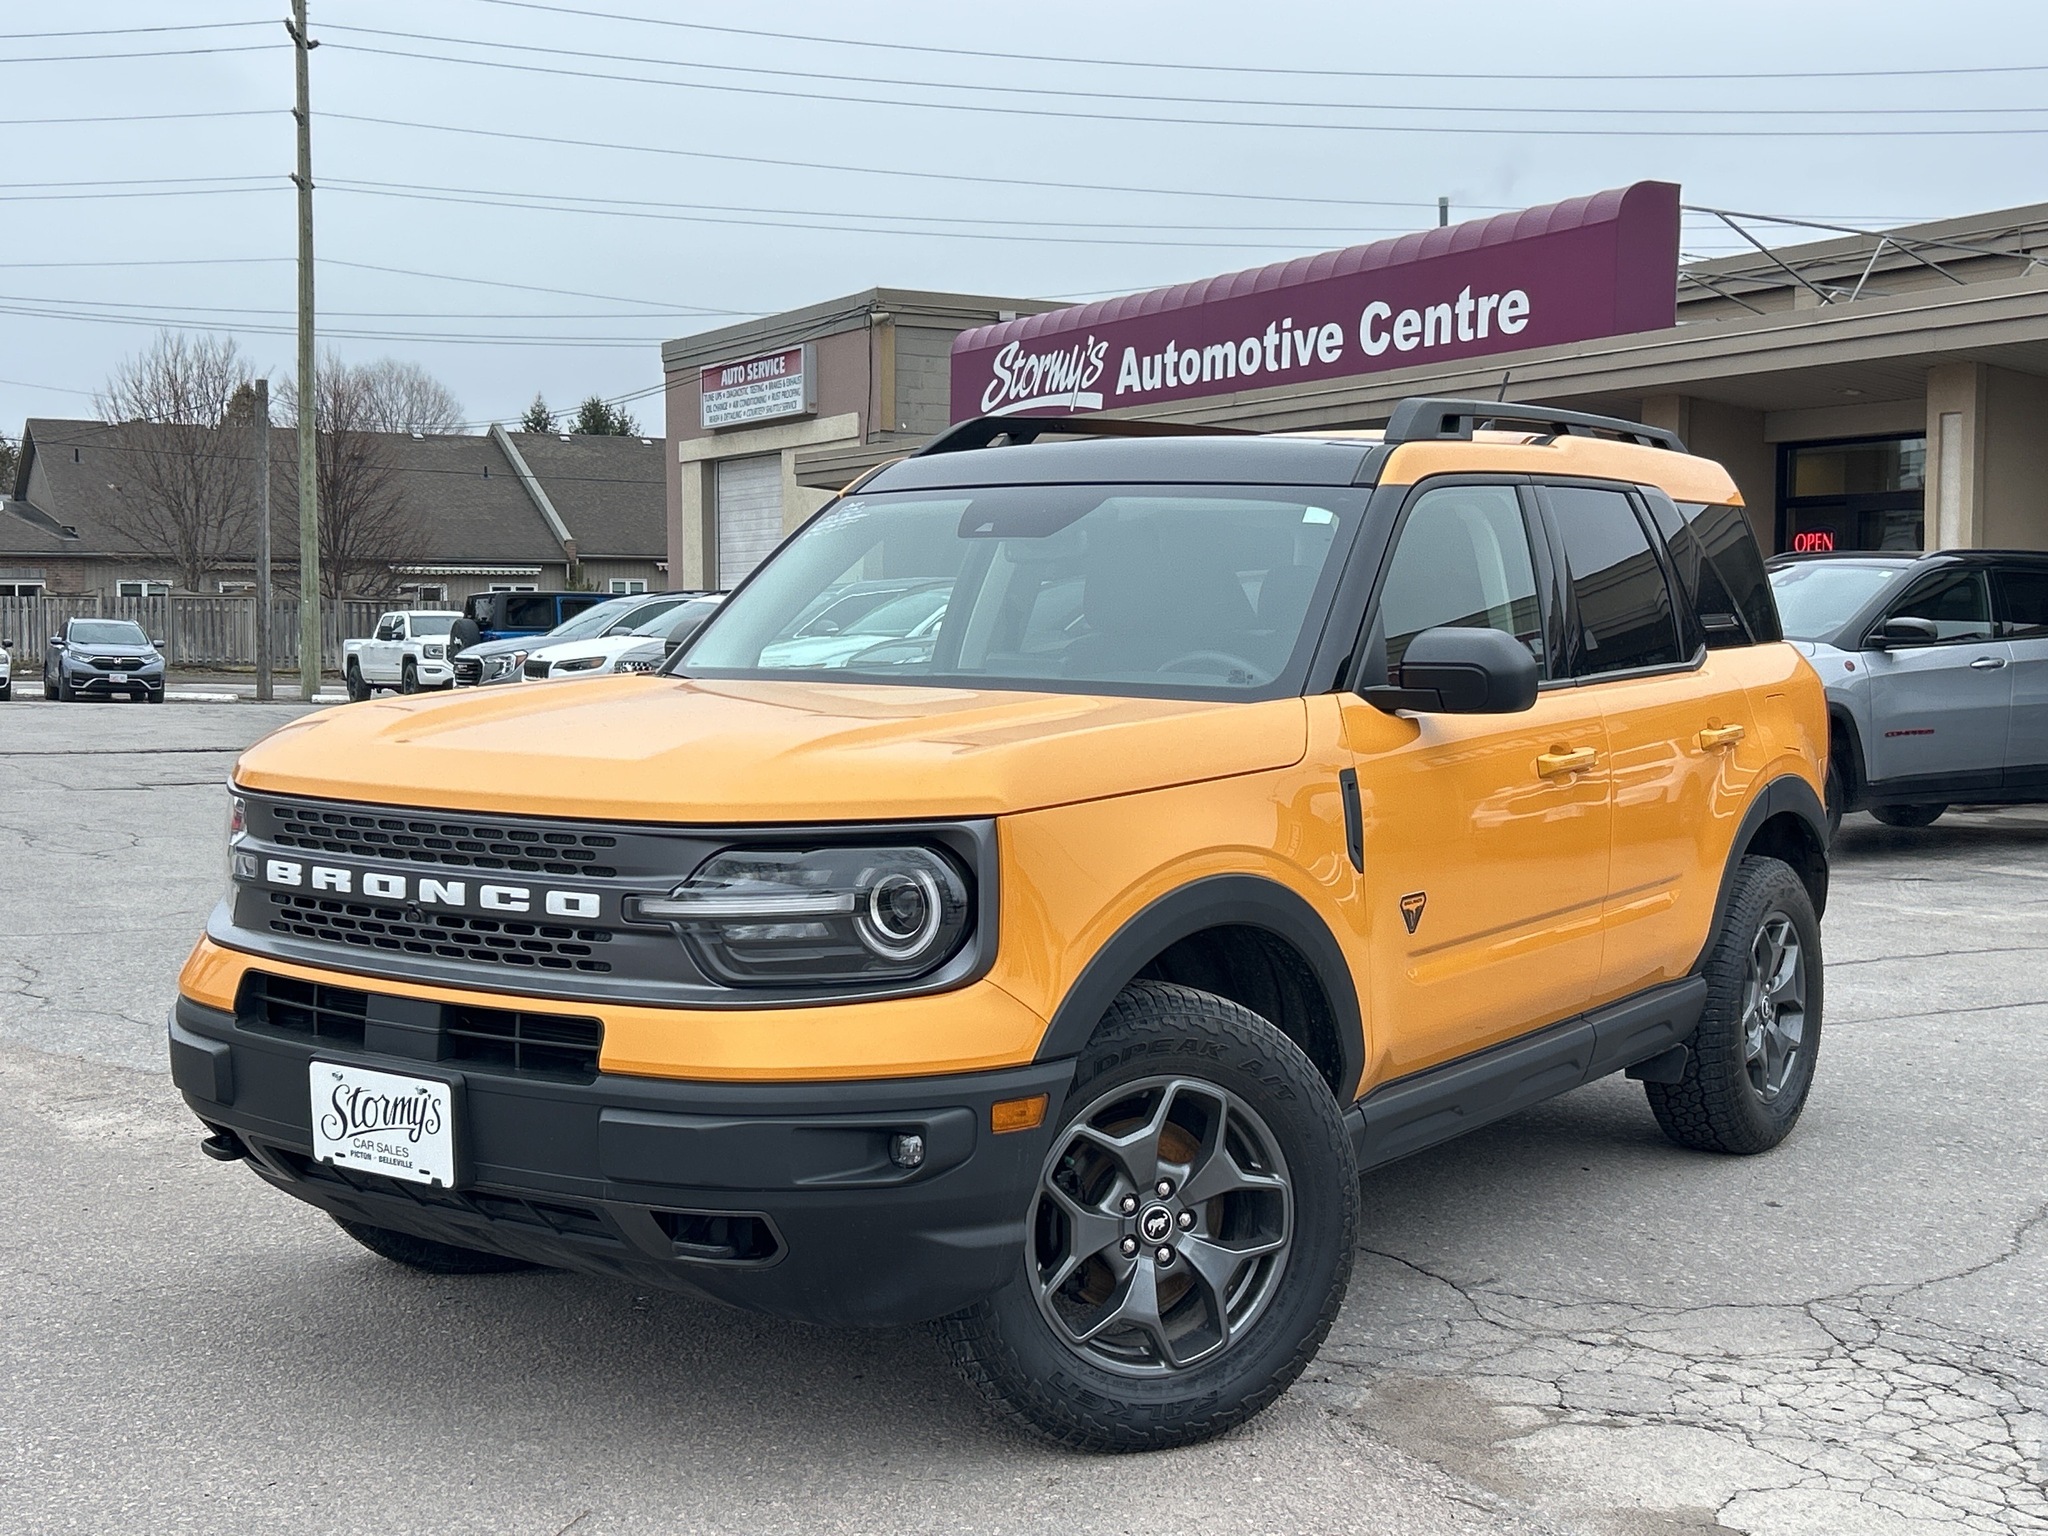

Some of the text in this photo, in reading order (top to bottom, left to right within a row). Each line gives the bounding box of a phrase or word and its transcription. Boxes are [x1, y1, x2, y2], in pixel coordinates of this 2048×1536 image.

[981, 285, 1531, 413] Stormy's Automotive Centre
[721, 356, 786, 387] AUTO SERVICE
[1794, 532, 1834, 553] OPEN
[266, 859, 601, 919] BRONCO
[321, 1083, 442, 1143] Stormy's
[353, 1138, 410, 1158] CAR SALES
[378, 1155, 414, 1169] BELLEVILLE
